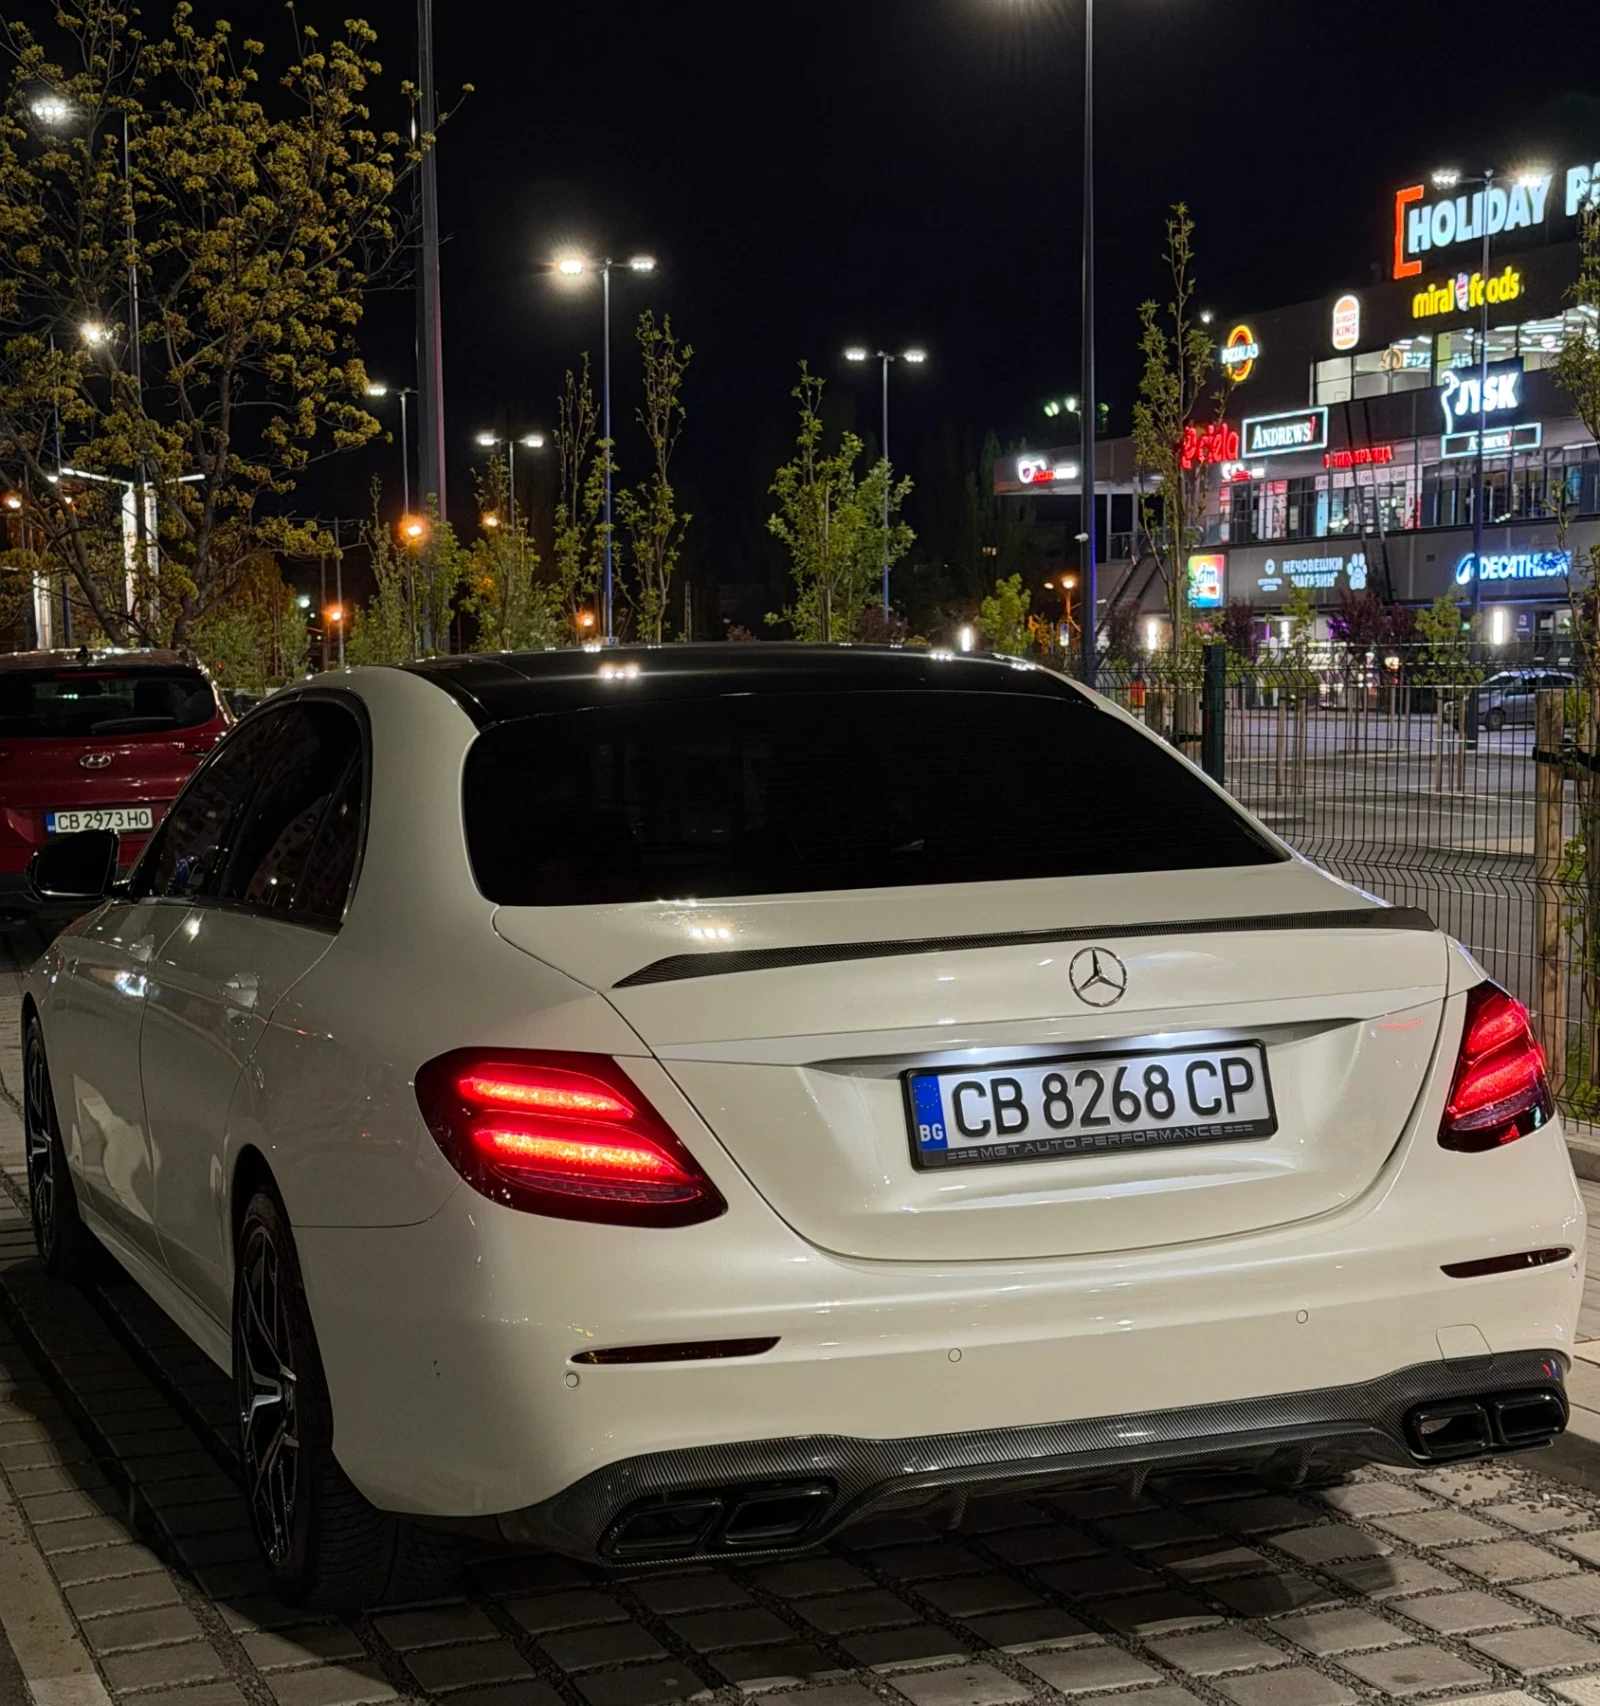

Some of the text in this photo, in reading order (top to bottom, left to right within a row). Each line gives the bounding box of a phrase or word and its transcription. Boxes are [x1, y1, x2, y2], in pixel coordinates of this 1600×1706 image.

[1408, 174, 1552, 254] HOLIDAY
[1412, 279, 1455, 318] miral
[1336, 322, 1356, 337] KING
[1455, 372, 1518, 416] JYSK
[1252, 421, 1311, 450] ANDREWS
[1199, 564, 1216, 584] dm
[1283, 556, 1343, 574] НЕЧОВЕШКИ
[58, 814, 80, 830] CB
[83, 811, 125, 829] 2973
[952, 1056, 1254, 1138] CB 8268 CP
[919, 1123, 944, 1142] BG
[980, 1125, 1223, 1159] MGT AUTO PERFORMANCE
